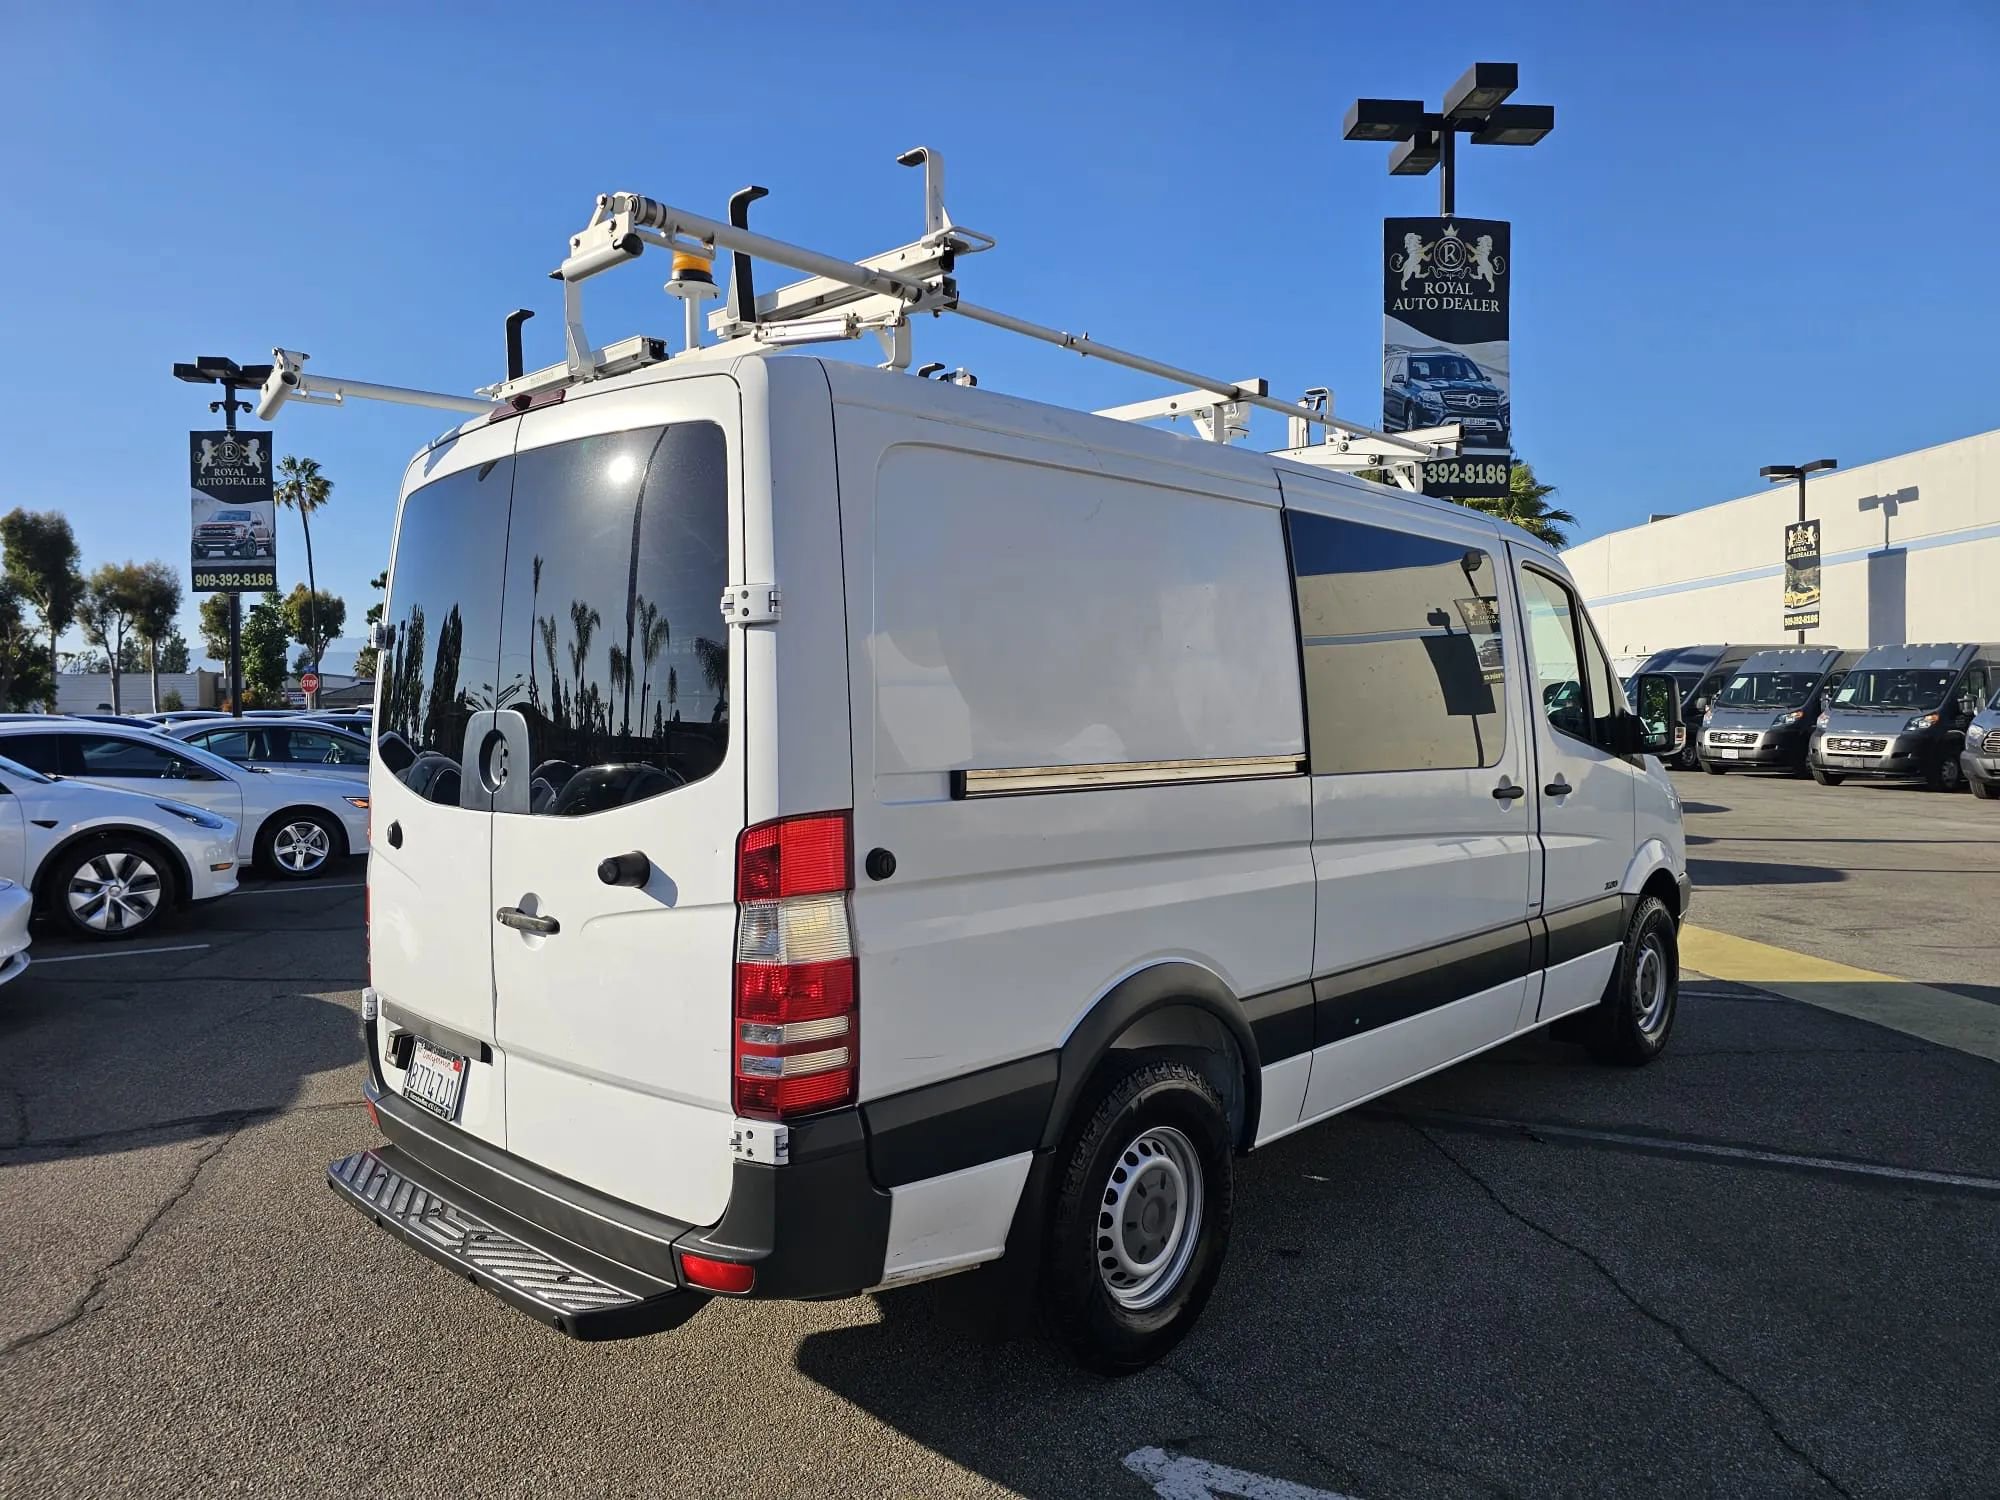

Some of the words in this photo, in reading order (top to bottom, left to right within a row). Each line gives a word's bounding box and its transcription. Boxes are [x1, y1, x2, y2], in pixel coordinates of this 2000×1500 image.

[1424, 281, 1473, 295] ROYAL
[1393, 297, 1438, 310] AUTO
[1442, 297, 1500, 312] DEALER
[214, 468, 246, 476] ROYAL
[197, 477, 224, 486] AUTO
[225, 477, 266, 486] DEALER
[195, 573, 273, 587] 909-392-8186
